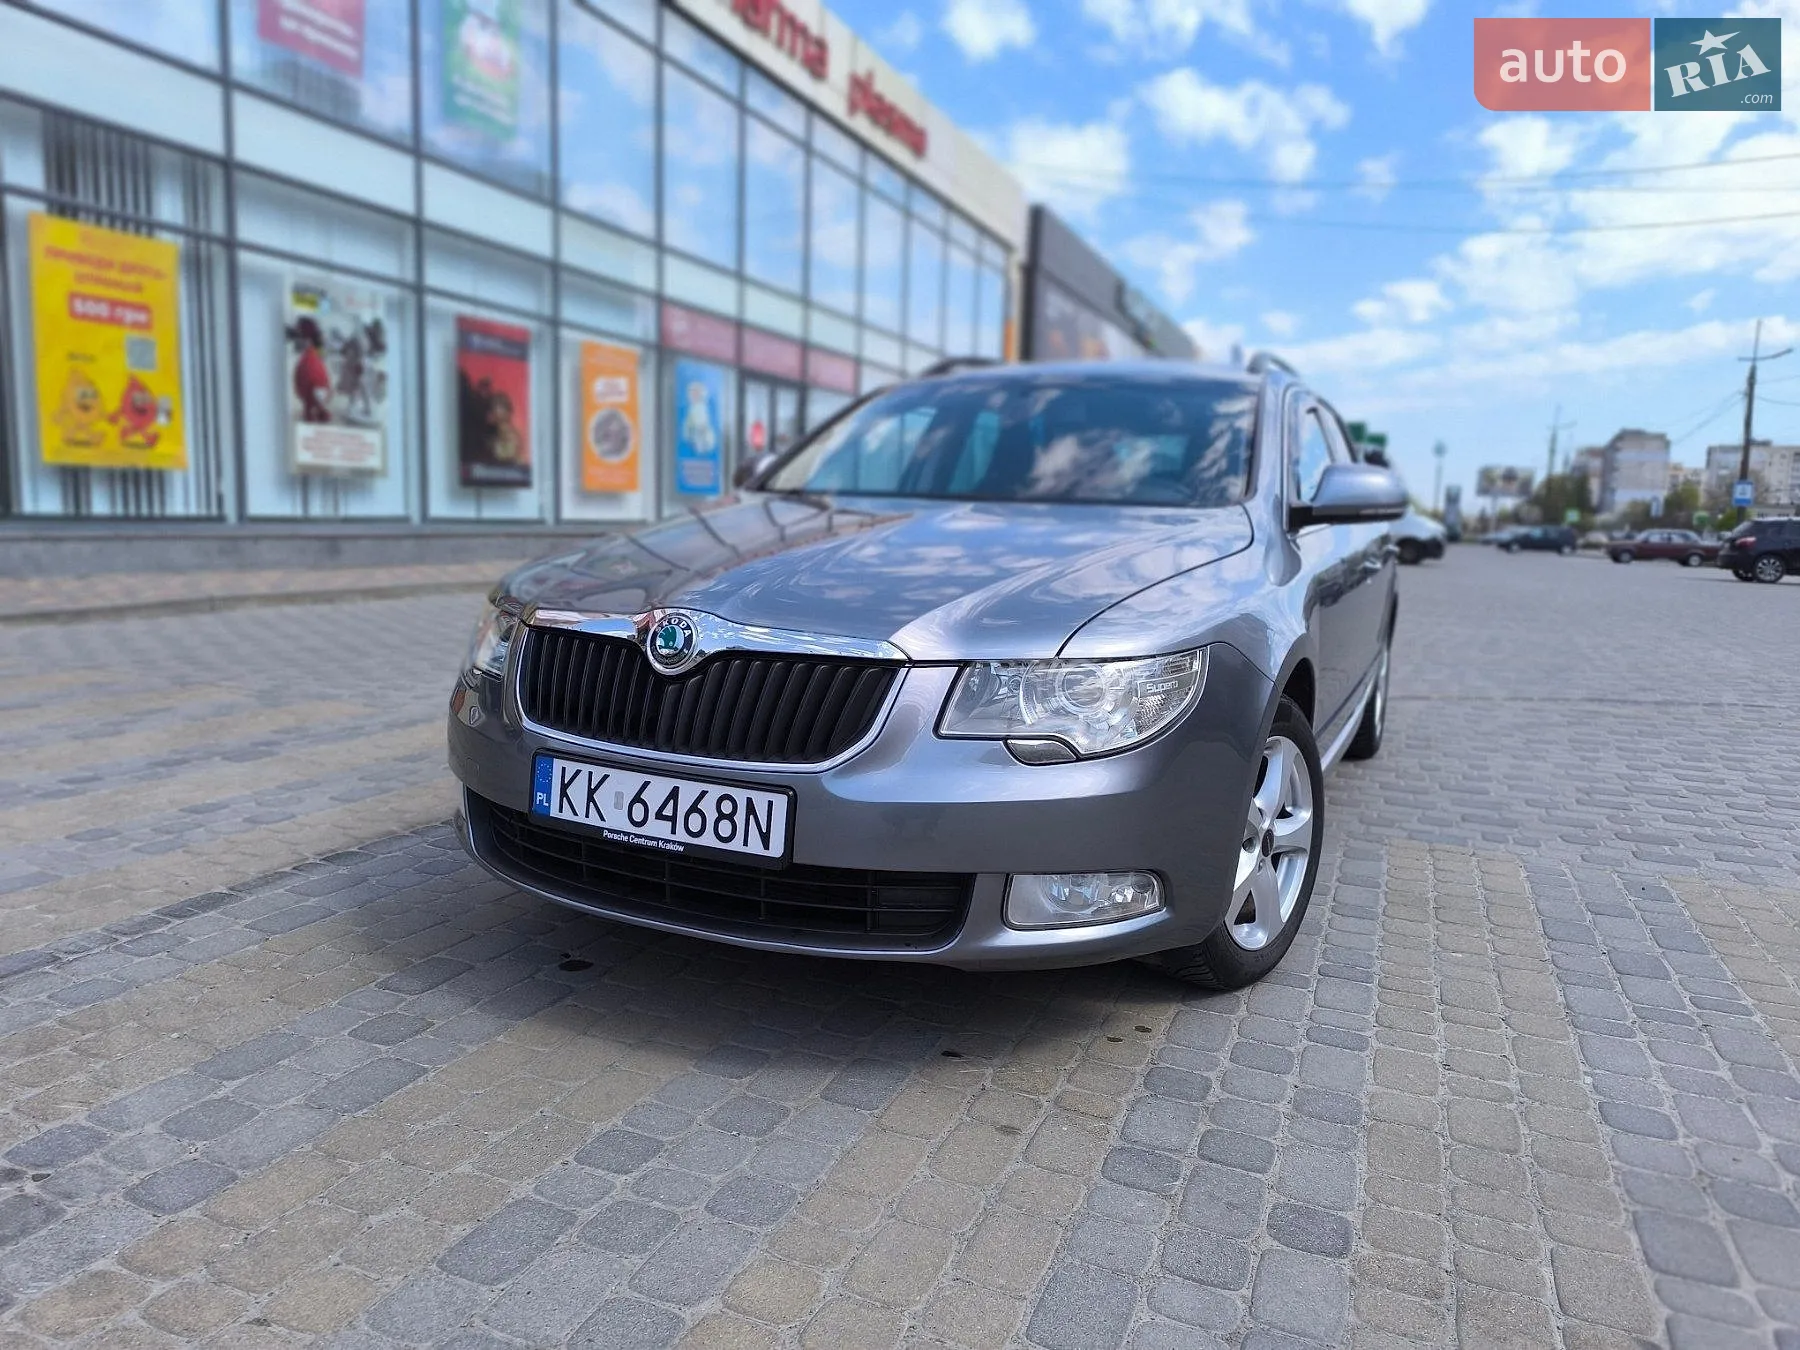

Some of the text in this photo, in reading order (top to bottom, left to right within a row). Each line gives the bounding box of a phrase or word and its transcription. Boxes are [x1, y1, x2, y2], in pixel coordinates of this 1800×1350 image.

[536, 792, 549, 807] PL
[558, 766, 774, 851] KK 6468N
[603, 829, 685, 852] Porsche Centrum Kraków
